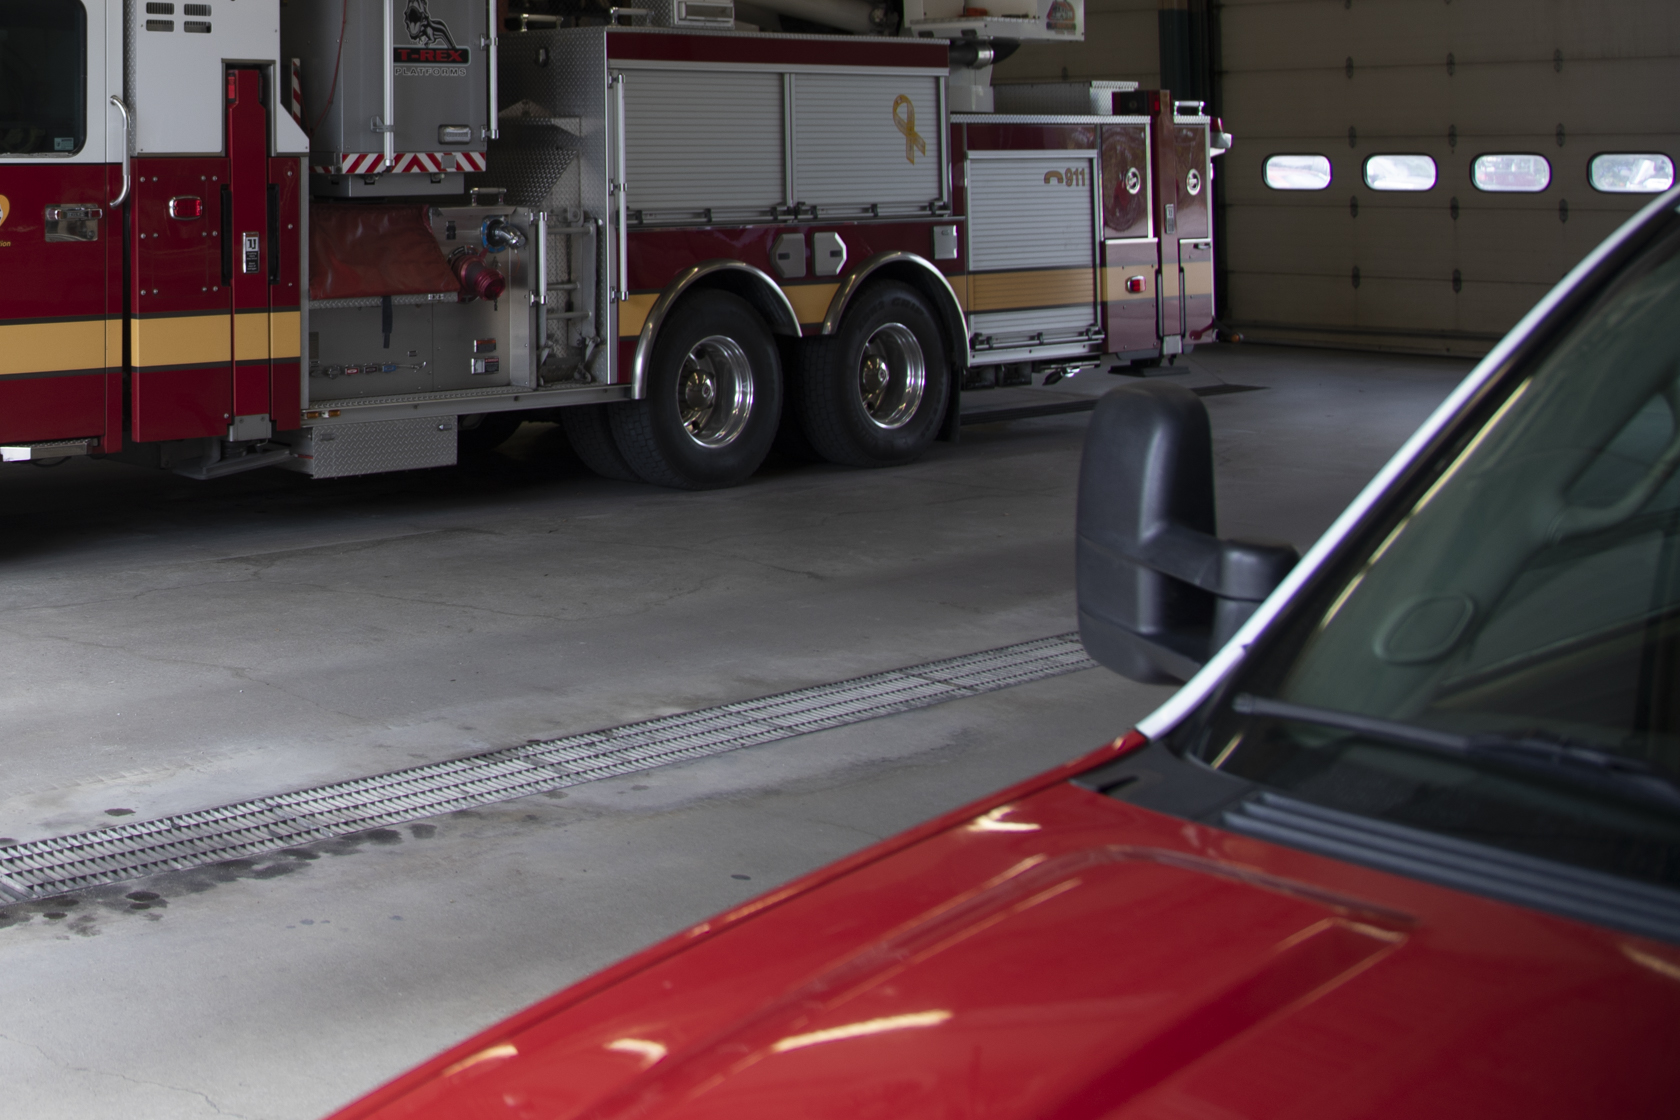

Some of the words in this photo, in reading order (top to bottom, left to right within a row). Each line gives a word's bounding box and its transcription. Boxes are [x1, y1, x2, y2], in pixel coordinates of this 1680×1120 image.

[398, 49, 463, 62] T-REX
[394, 67, 467, 77] PLATFORMS
[1064, 167, 1086, 187] 911
